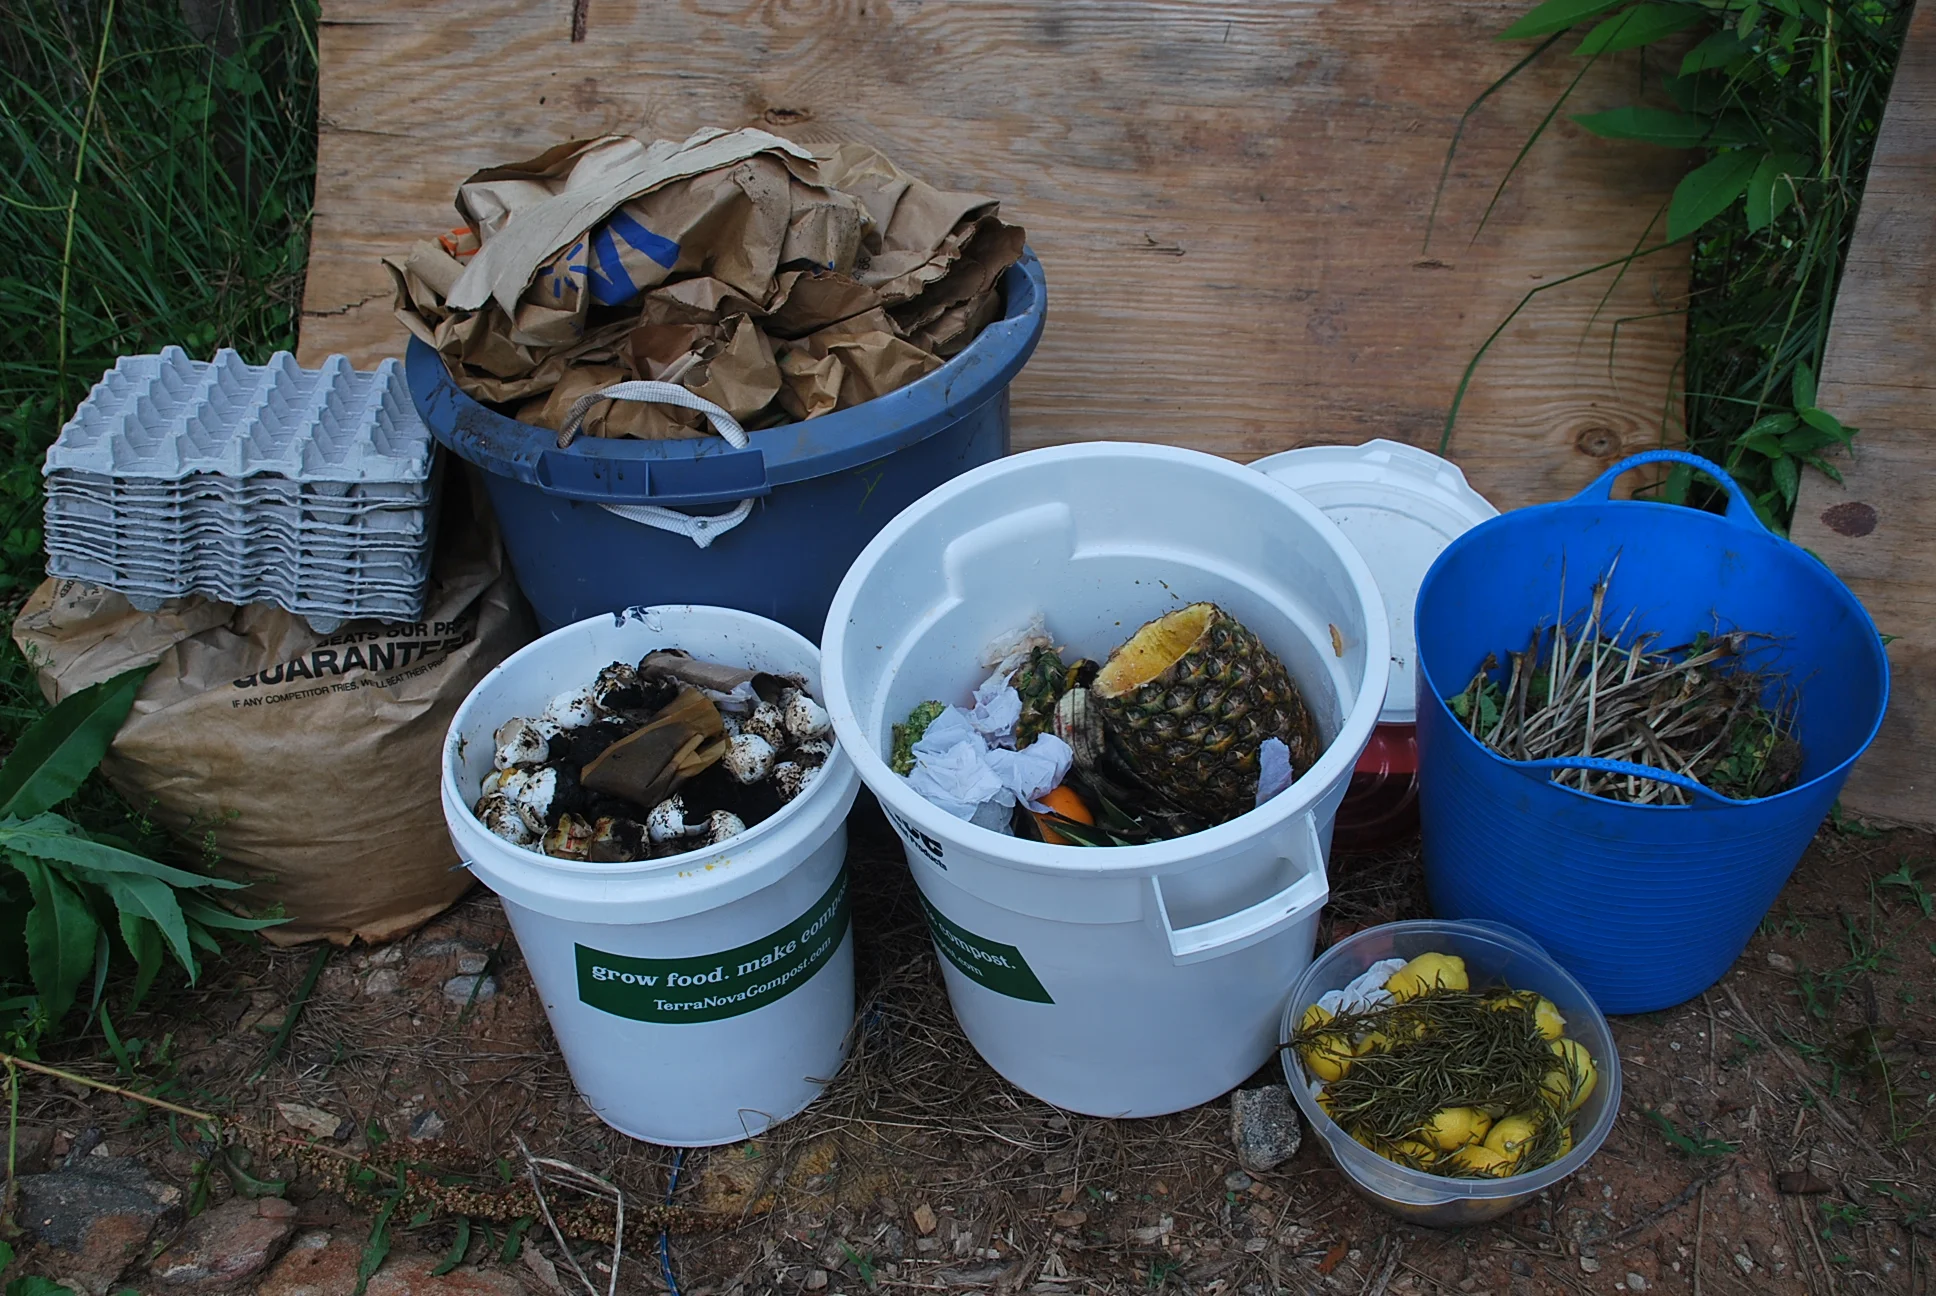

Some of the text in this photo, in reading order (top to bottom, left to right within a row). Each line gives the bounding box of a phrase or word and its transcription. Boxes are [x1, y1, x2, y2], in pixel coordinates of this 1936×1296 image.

[386, 621, 429, 638] OUR
[434, 617, 467, 636] PR
[232, 699, 241, 709] IF
[243, 696, 263, 708] ANY
[265, 686, 330, 705] COMPETITOR
[330, 681, 360, 693] TRIES,
[388, 673, 404, 687] BEAT
[404, 664, 428, 680] THEIR
[592, 965, 659, 987] grow
[666, 966, 730, 987] food.
[737, 940, 797, 977] make
[938, 923, 1017, 970] compost.
[653, 936, 831, 1011] TerraNovaCompost.com
